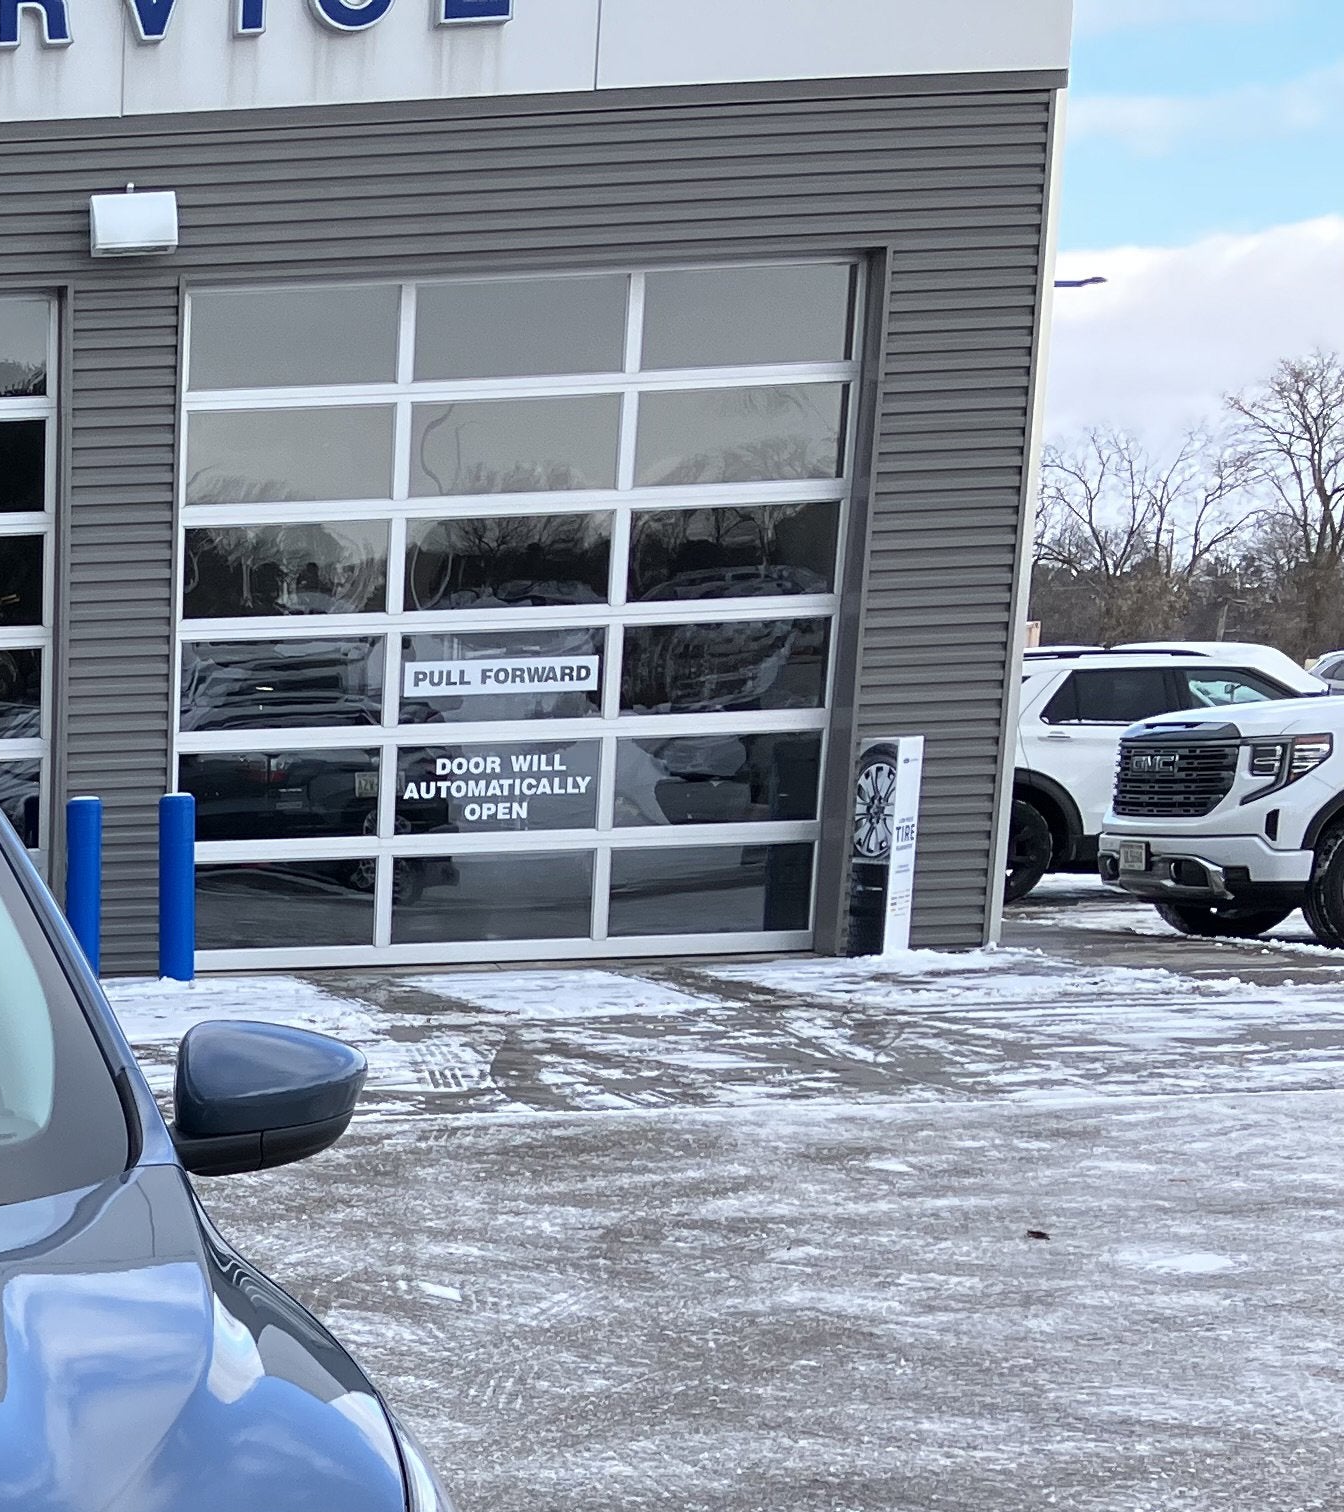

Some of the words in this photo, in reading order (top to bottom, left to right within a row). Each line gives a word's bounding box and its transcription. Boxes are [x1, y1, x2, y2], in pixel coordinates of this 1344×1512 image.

[413, 669, 471, 687] PULL
[480, 664, 591, 685] FORWARD
[435, 755, 502, 775] DOOR
[511, 753, 567, 772] WILL
[1133, 755, 1178, 772] GMC
[403, 776, 592, 800] AUTOMATICALLY
[464, 802, 528, 821] OPEN
[895, 824, 916, 843] TIRE
